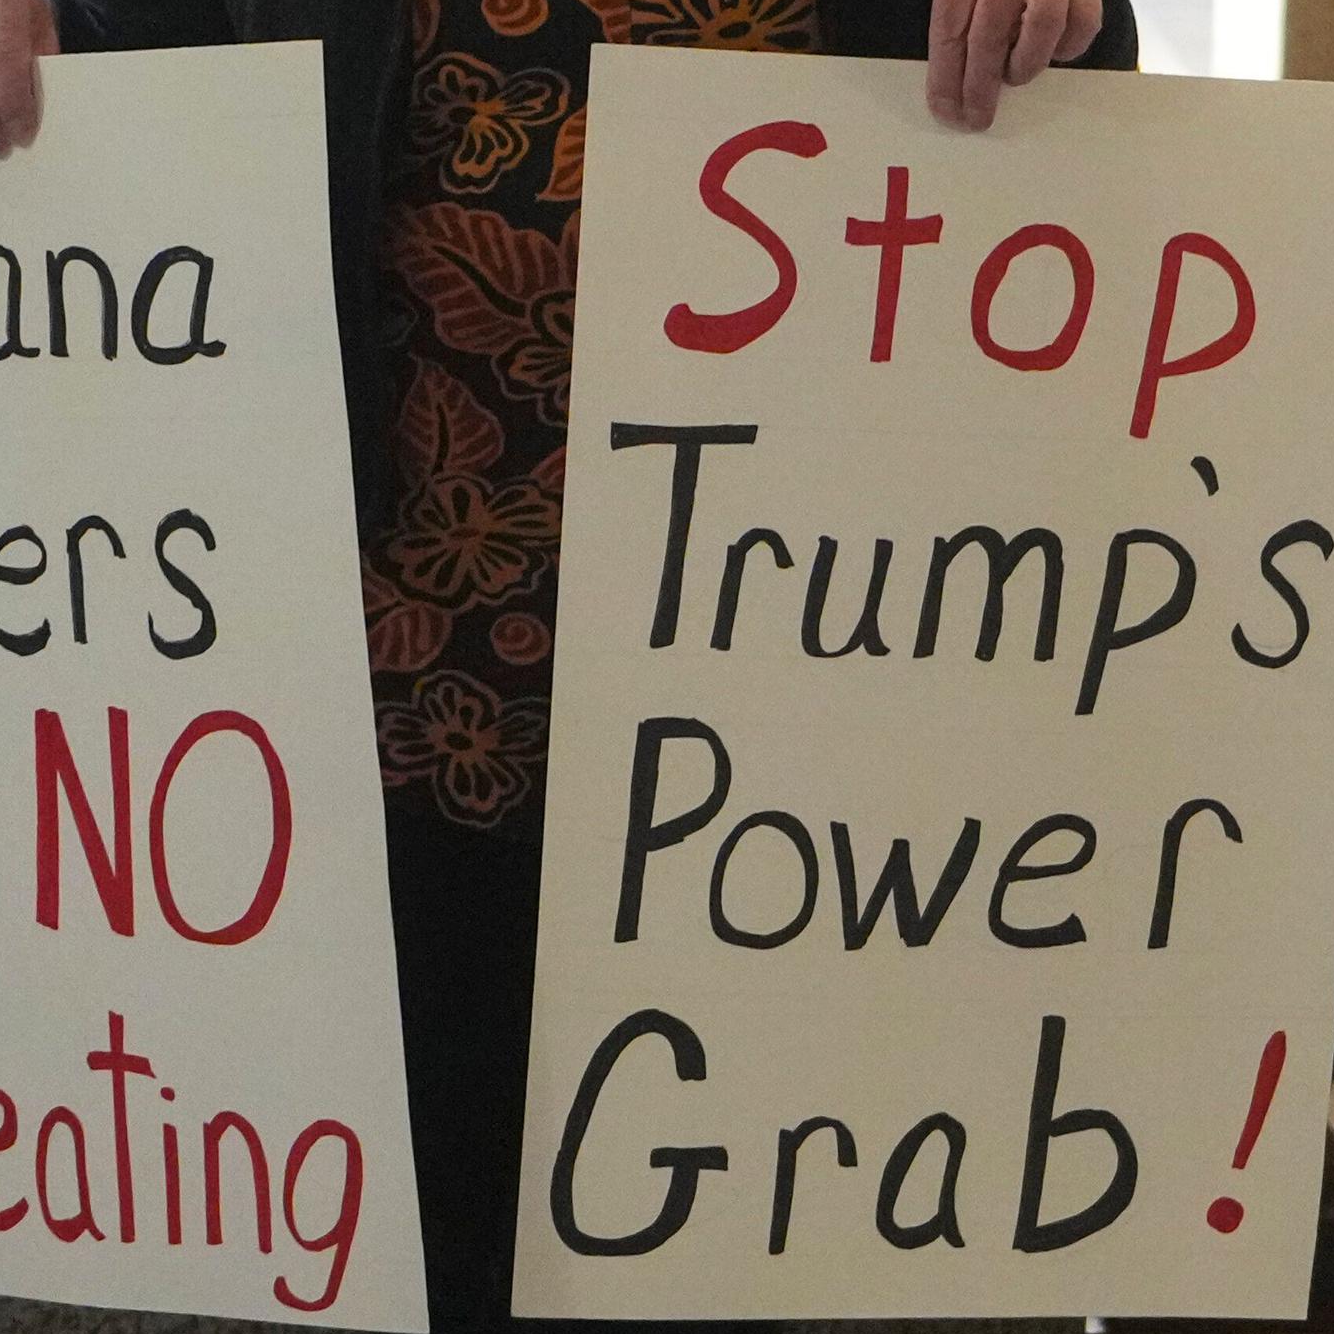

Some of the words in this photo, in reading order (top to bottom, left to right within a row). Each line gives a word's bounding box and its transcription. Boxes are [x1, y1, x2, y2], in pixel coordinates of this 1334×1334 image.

[663, 120, 1257, 439] Stop
[34, 706, 293, 946] NO
[613, 716, 1244, 951] Power
